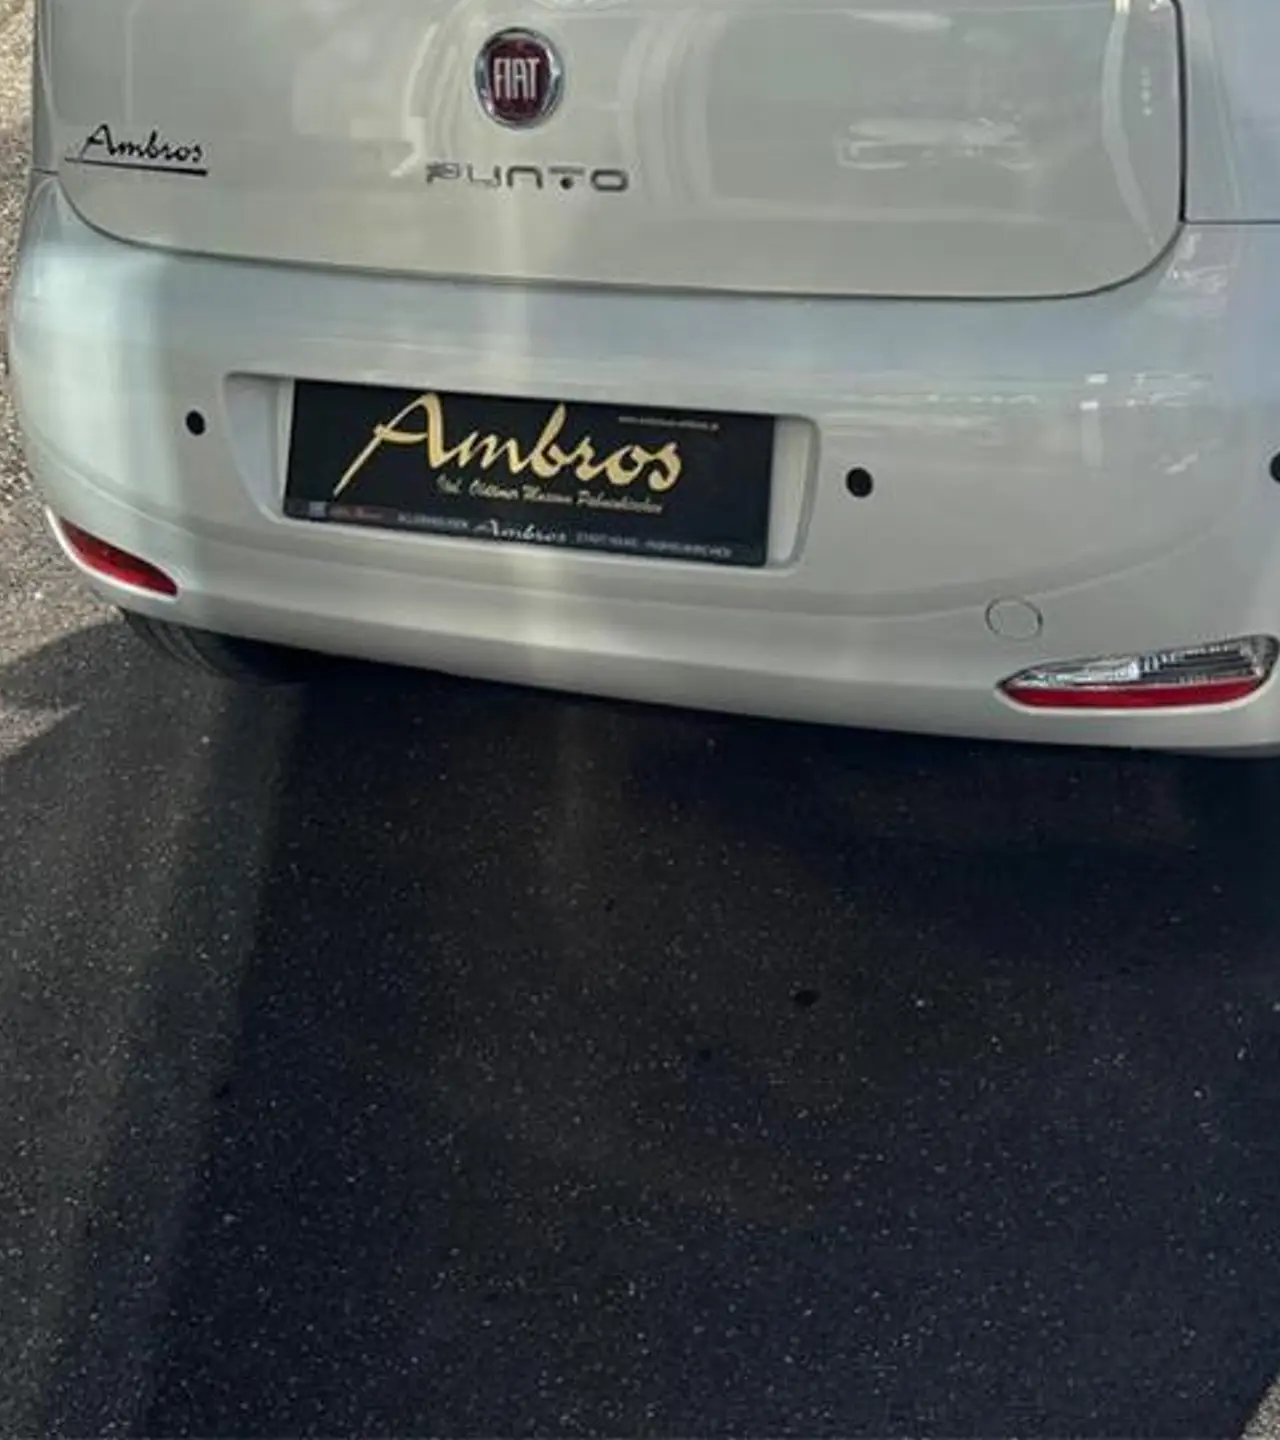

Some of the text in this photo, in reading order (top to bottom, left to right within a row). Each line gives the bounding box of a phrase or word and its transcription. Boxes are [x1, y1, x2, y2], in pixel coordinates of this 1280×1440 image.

[493, 56, 540, 101] FIAT
[79, 122, 204, 164] Ambros
[425, 162, 630, 192] PUNTO
[333, 392, 683, 496] Ambros
